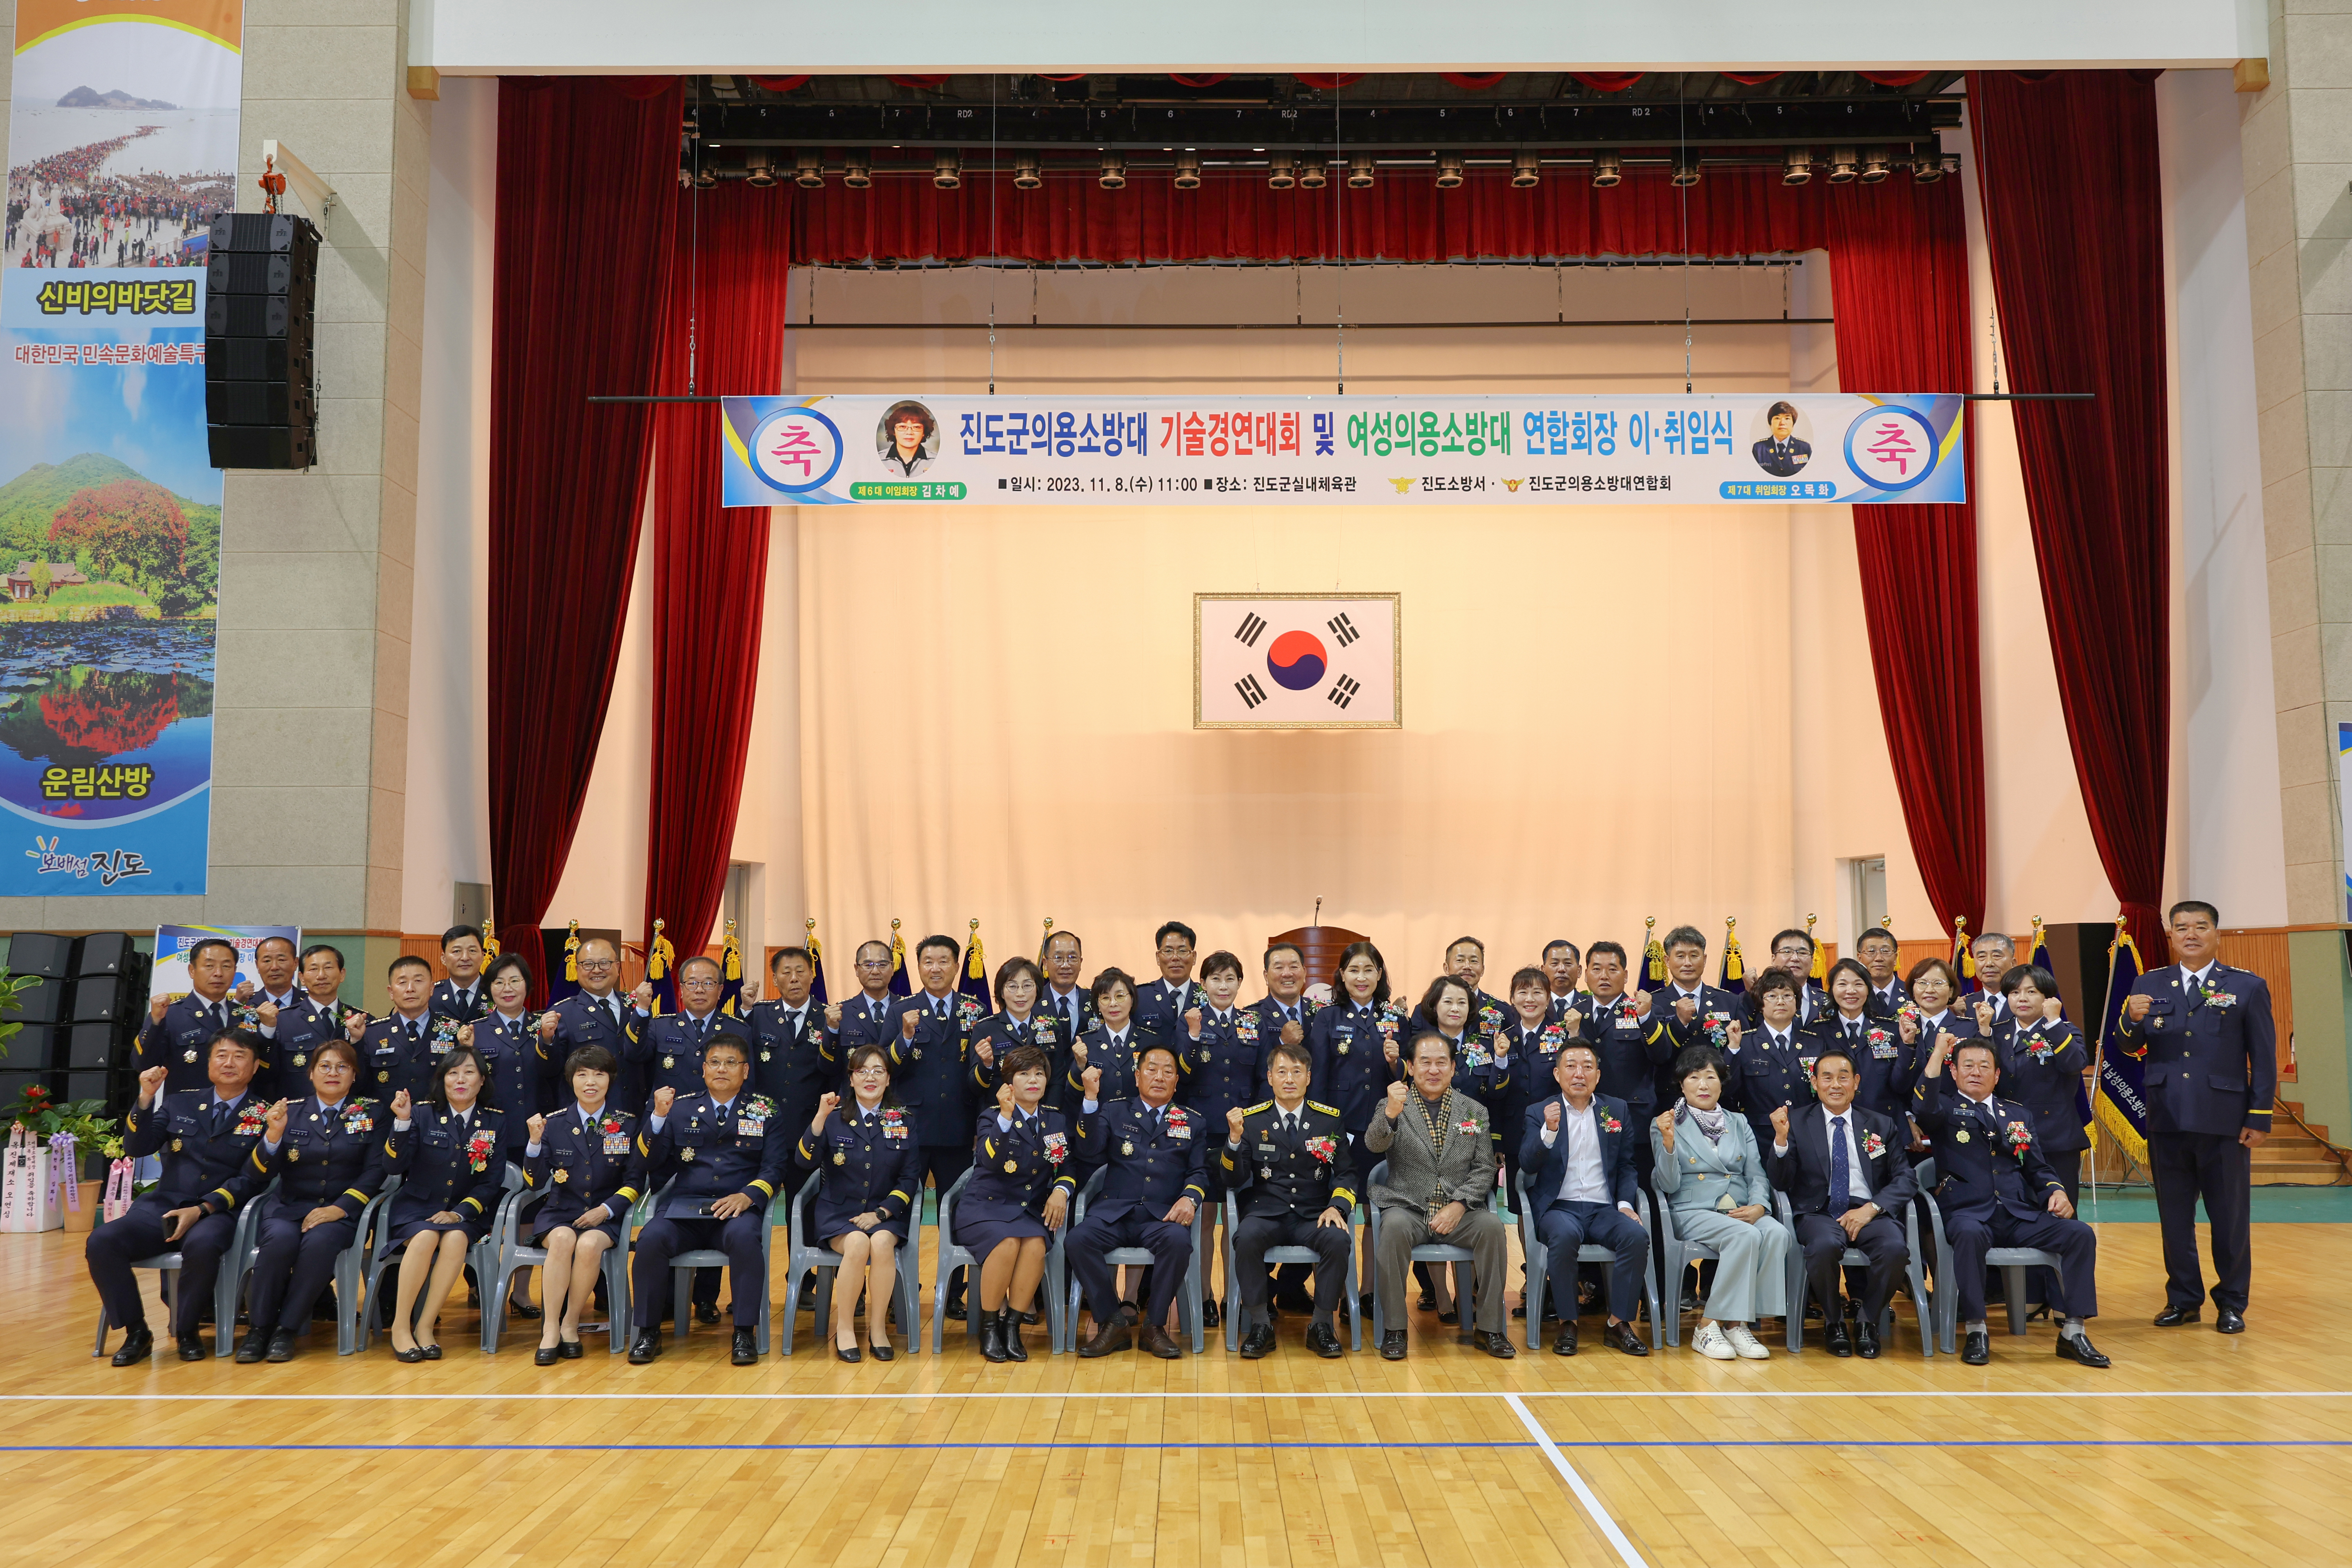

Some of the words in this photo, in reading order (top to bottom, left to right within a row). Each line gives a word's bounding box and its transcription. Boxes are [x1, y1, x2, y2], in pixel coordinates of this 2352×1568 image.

[1440, 109, 1445, 117] 5
[1508, 108, 1513, 116] 6
[39, 282, 194, 312] 신비의바닷길
[15, 344, 78, 364] 대한민국
[961, 412, 1147, 457] 진도군의용소방대
[1161, 412, 1300, 457] 기술경연대회
[1314, 412, 1334, 456] 및
[1348, 412, 1510, 457] 여성의용소방대
[1524, 411, 1617, 456] 연합회장
[1630, 410, 1732, 455] 이·취임식
[771, 425, 822, 477] 축
[1866, 423, 1916, 475] 축
[886, 485, 918, 497] 이임회장
[1011, 476, 1041, 492] 일시:
[1047, 477, 1084, 492] 2023.
[1090, 477, 1110, 492] 11.
[1158, 477, 1197, 491] 11:00
[1216, 476, 1247, 492] 장소:
[1253, 476, 1357, 492] 진도군실내체육관
[1422, 476, 1485, 492] 진도소방서
[1529, 475, 1671, 492] 진도군의용소방대연합회
[1755, 485, 1787, 496] 취임회장
[42, 766, 151, 797] 운림산방
[39, 853, 89, 878] 보배섬
[92, 849, 151, 886] 진도
[2103, 1067, 2147, 1119] 남성의용소방대
[6, 1141, 19, 1186] 옥진제재소
[27, 1172, 35, 1189] 취임을
[3, 1192, 14, 1219] 오연심
[26, 1191, 36, 1218] 축하합니다
